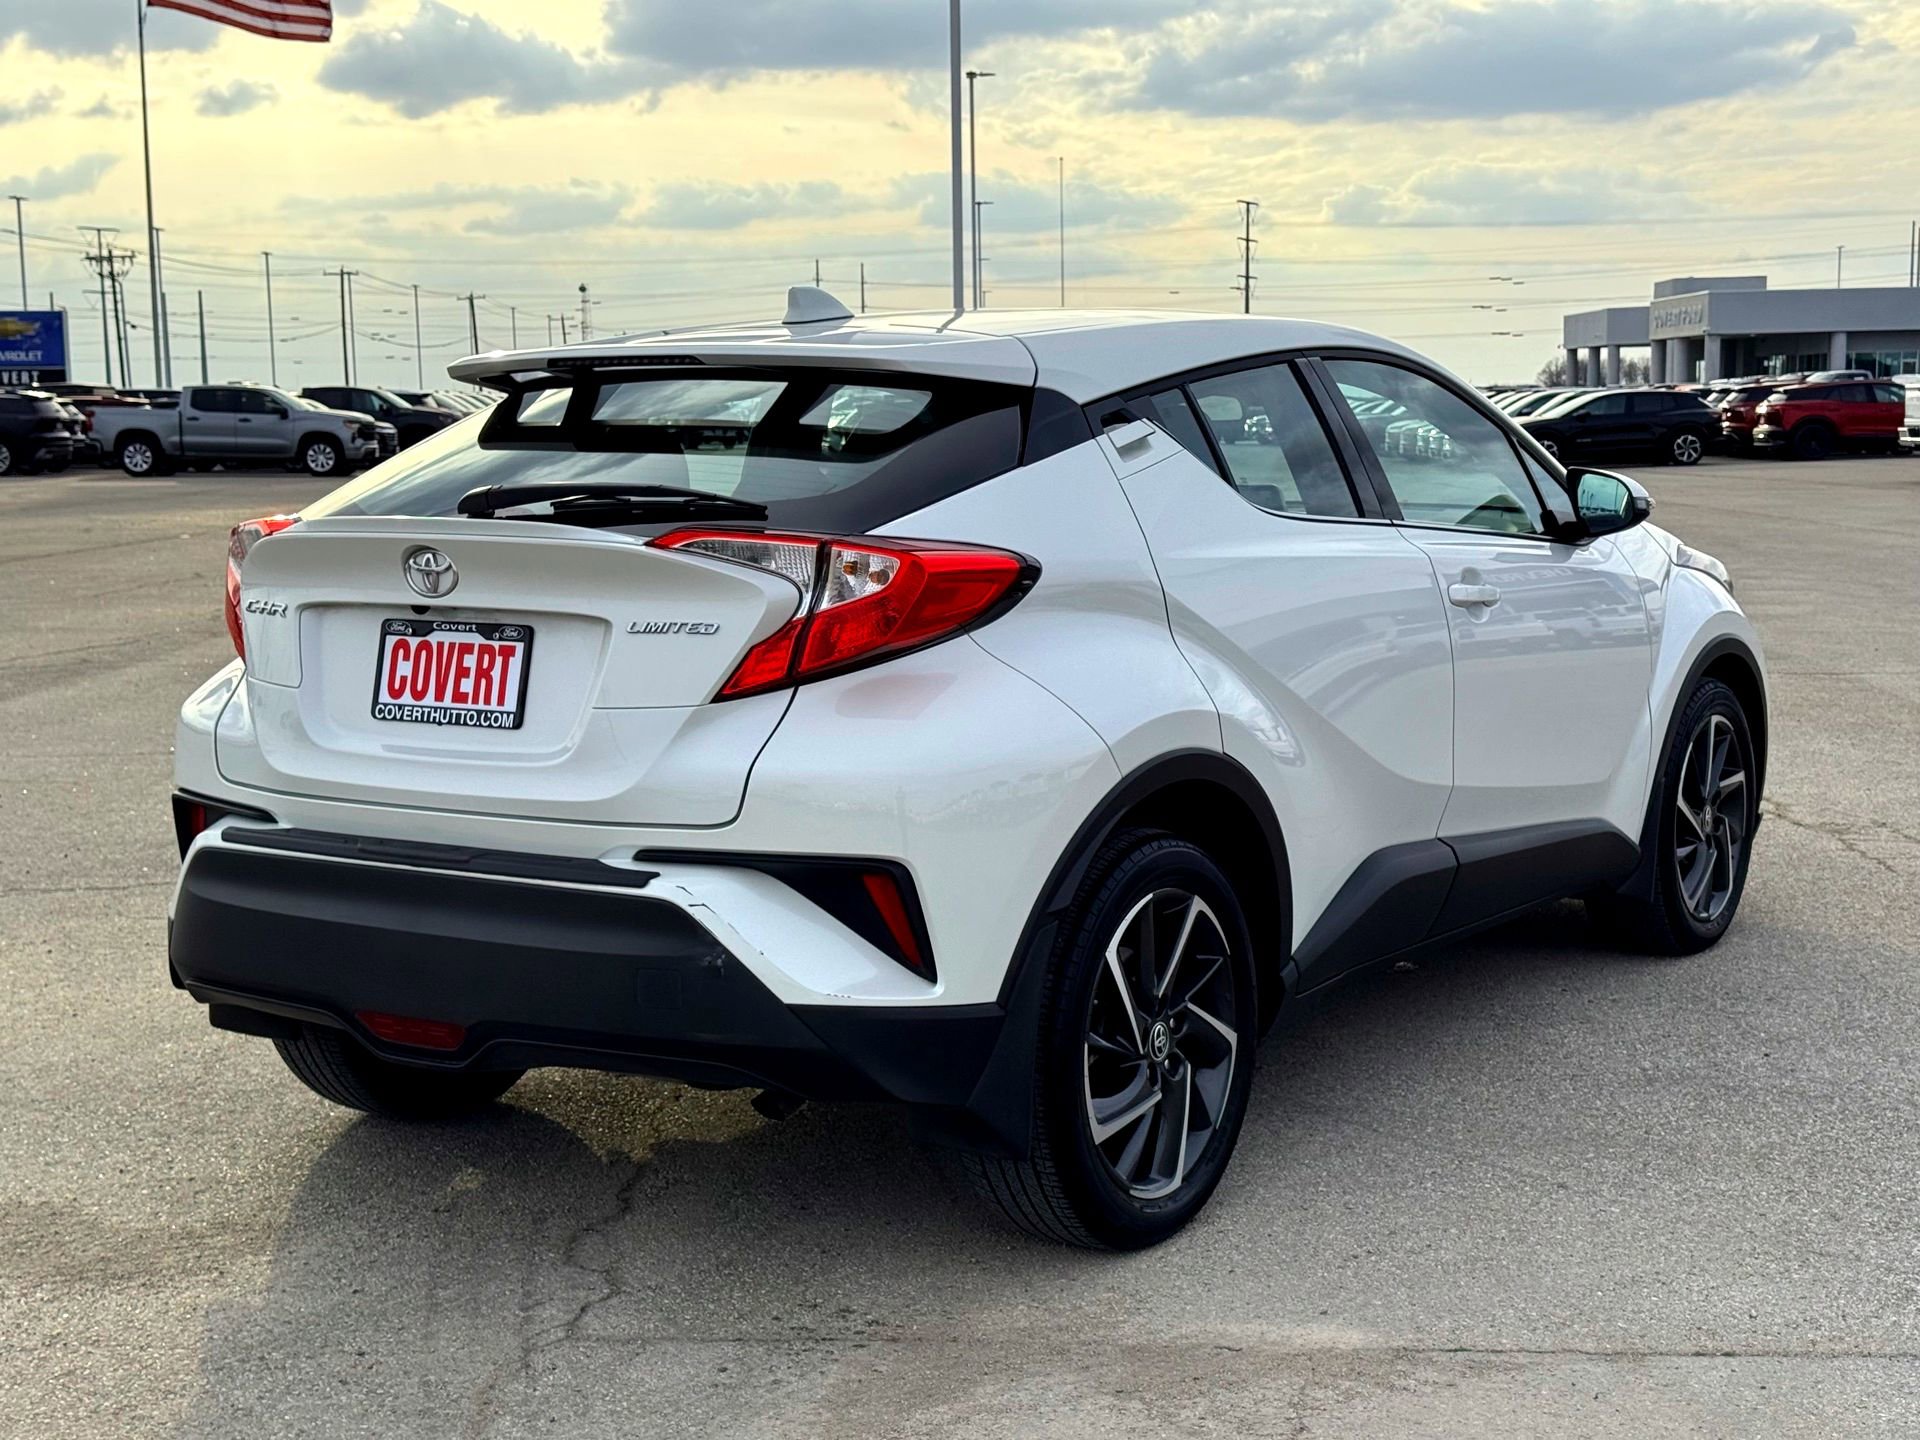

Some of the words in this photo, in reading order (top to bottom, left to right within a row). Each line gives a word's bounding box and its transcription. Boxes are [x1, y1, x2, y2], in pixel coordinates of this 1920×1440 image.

[433, 621, 477, 631] Covert
[626, 621, 720, 634] LIMITED
[387, 638, 517, 707] COVERT
[375, 704, 515, 728] COVERTHUTTO.COM
